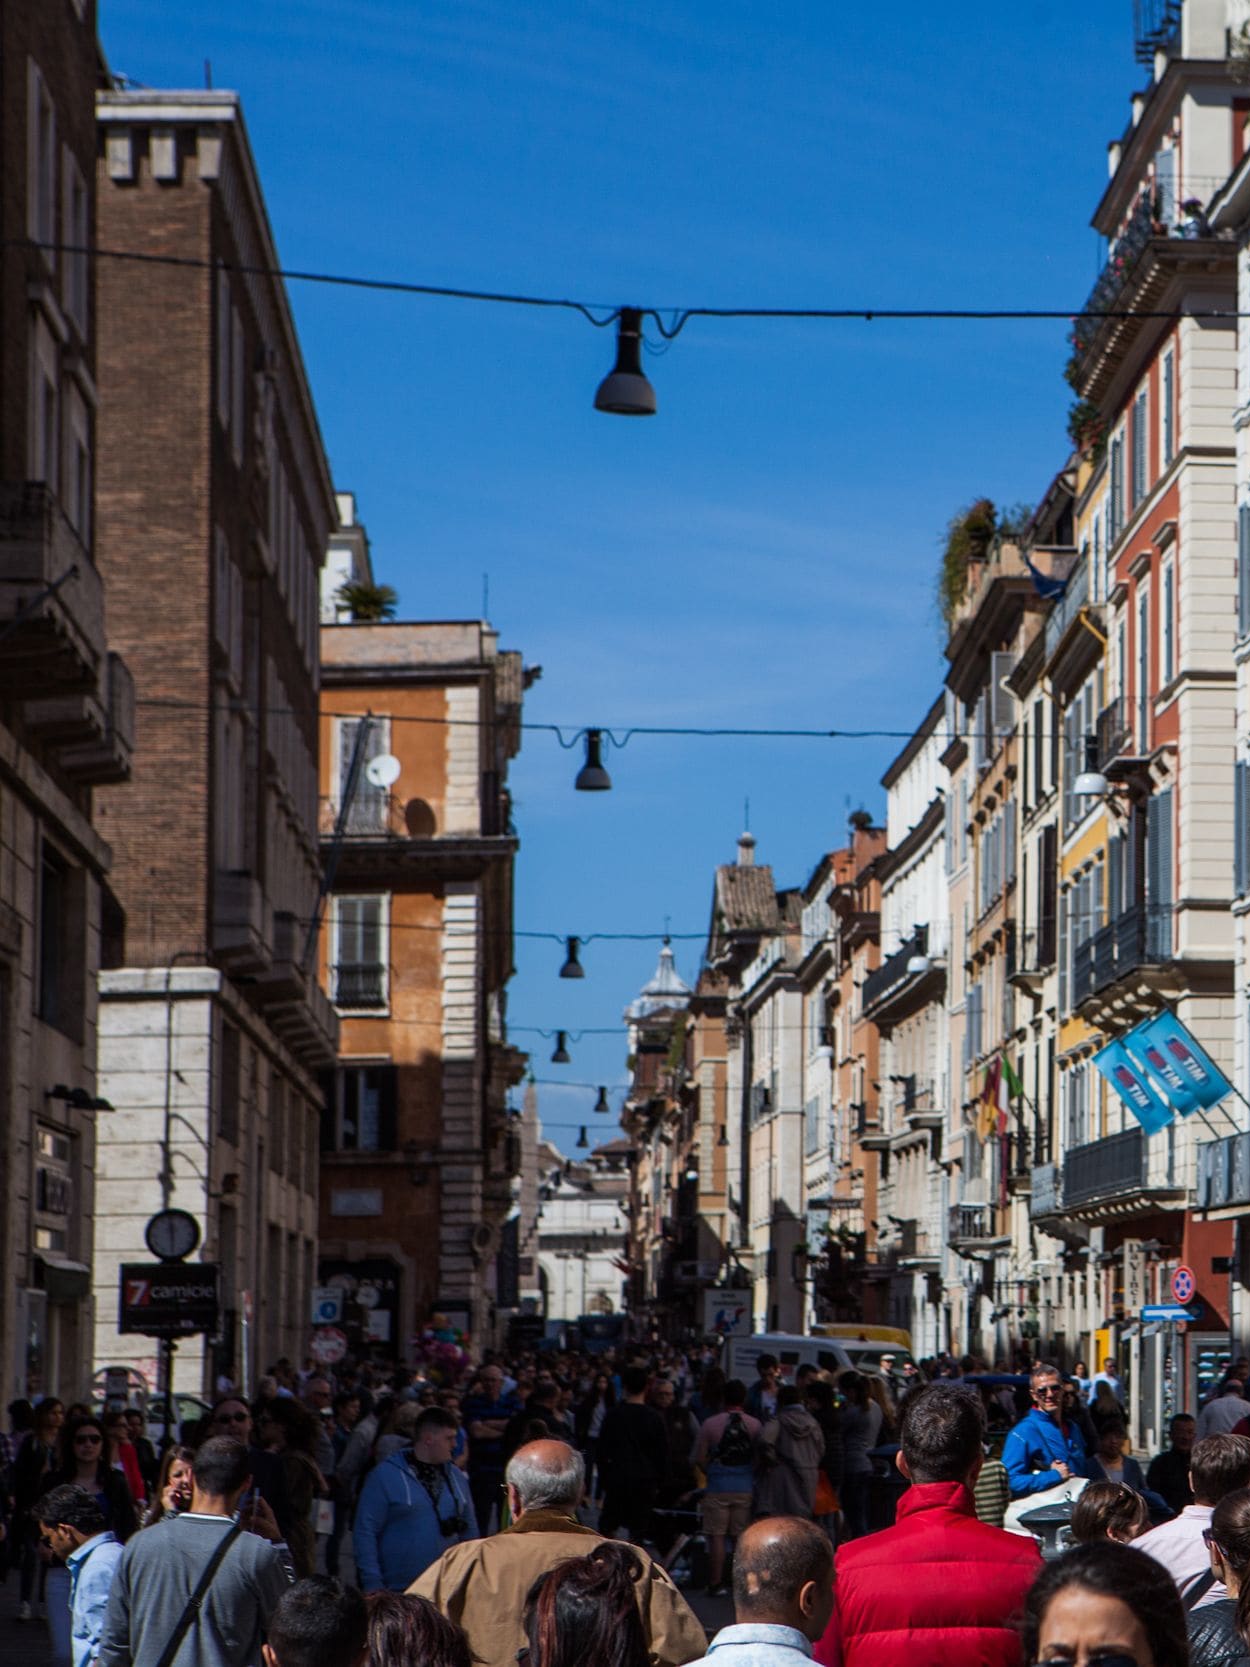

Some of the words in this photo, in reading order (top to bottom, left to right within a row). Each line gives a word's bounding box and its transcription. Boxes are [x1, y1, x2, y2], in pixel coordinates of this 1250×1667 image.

[1161, 1065, 1184, 1089] TIM
[1183, 1056, 1206, 1081] TIM
[1127, 1083, 1151, 1107] TIM
[128, 1281, 148, 1305] 7
